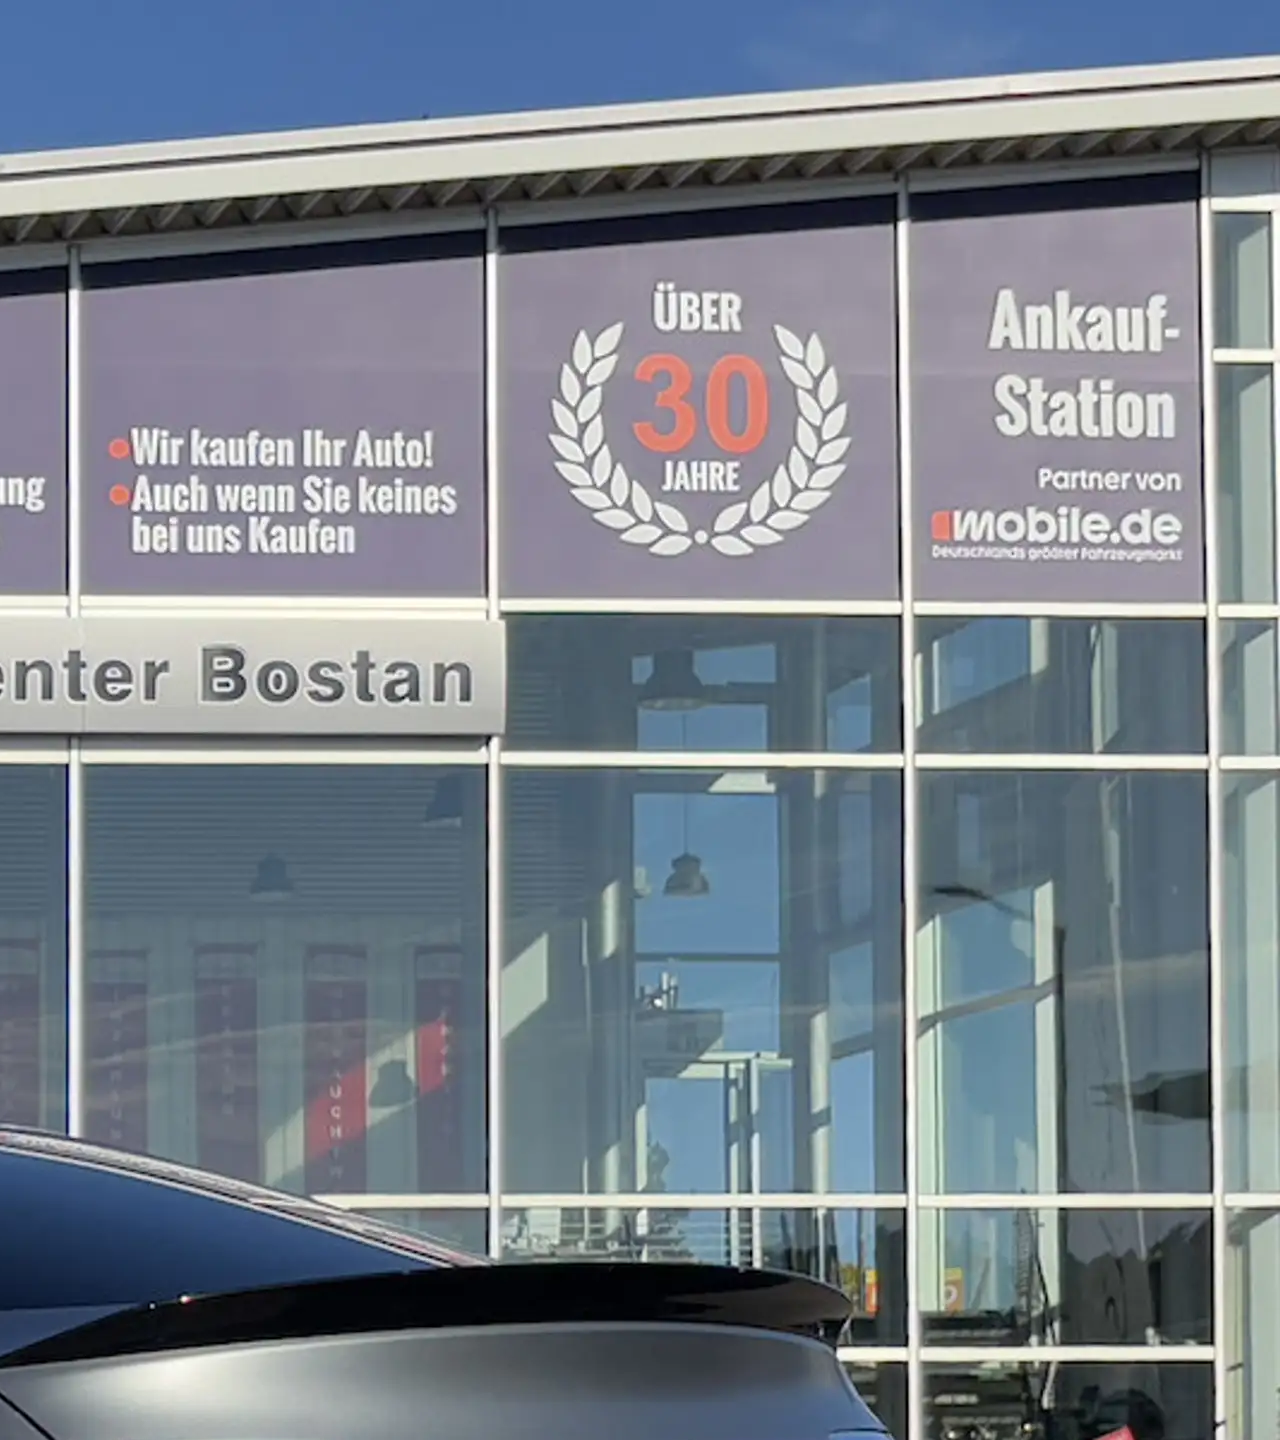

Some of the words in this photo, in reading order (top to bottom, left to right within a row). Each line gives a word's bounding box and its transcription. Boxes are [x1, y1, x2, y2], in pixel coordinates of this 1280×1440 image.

[653, 281, 742, 332] ÜBER
[990, 289, 1180, 352] Ankauf-
[632, 354, 770, 453] 30
[995, 375, 1177, 438] Station
[131, 428, 185, 466] Wir
[191, 429, 295, 467] kaufen
[303, 430, 347, 467] Ihr
[353, 430, 433, 468] Auto!
[131, 475, 208, 513] Auch
[215, 484, 295, 513] wenn
[302, 476, 351, 514] Sie
[358, 477, 457, 515] keines
[662, 461, 741, 492] JAHRE
[1039, 468, 1132, 491] Partner
[1135, 473, 1182, 491] von
[132, 515, 179, 553] bei
[186, 523, 241, 553] uns
[249, 515, 355, 554] Kaufen
[952, 507, 1183, 544] mobile.de
[201, 645, 472, 704] Bostan
